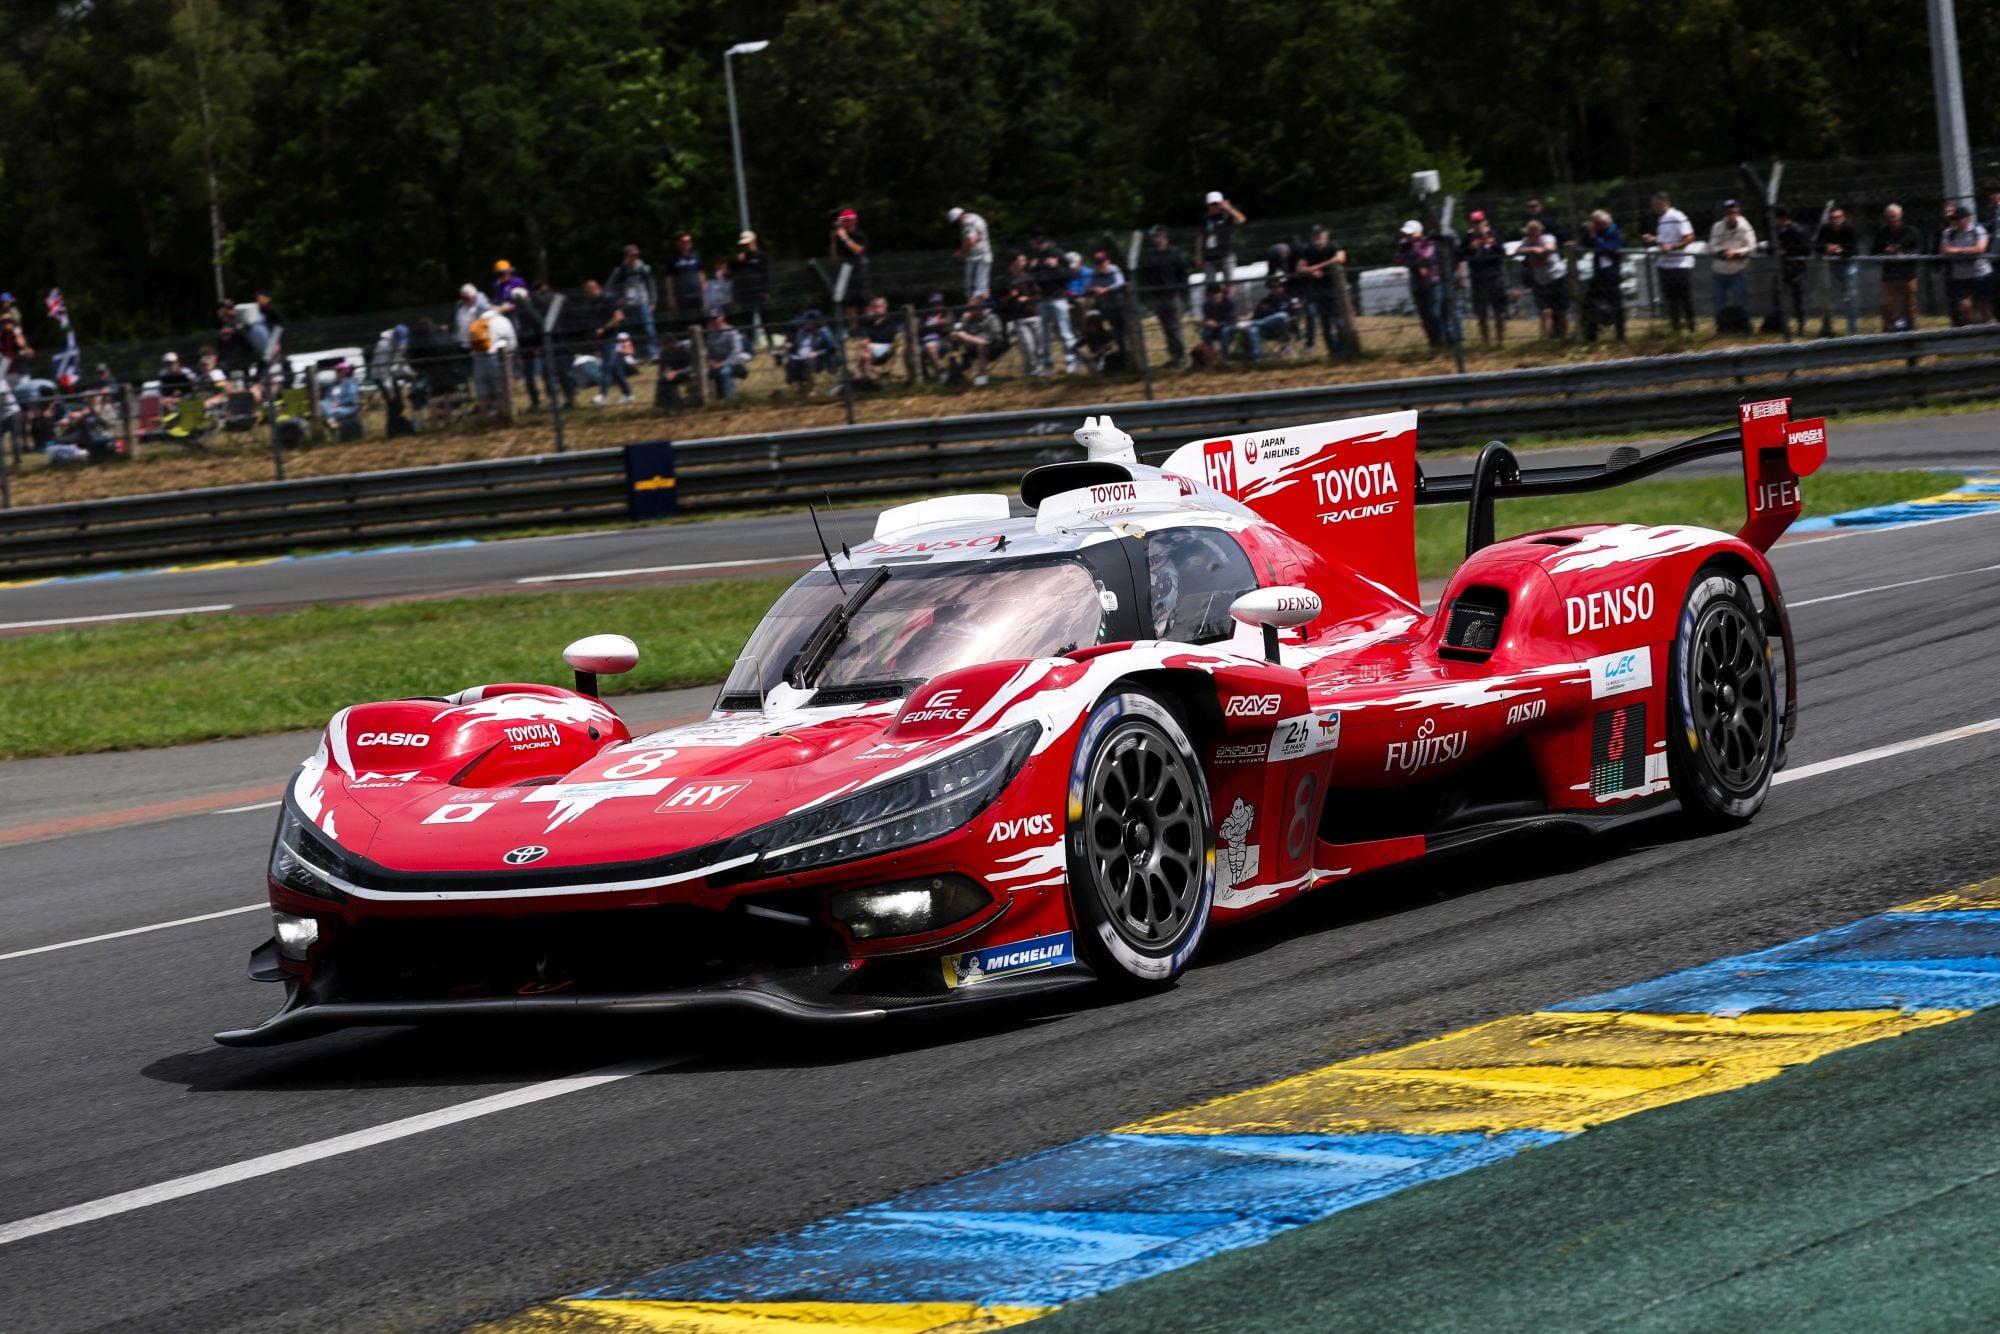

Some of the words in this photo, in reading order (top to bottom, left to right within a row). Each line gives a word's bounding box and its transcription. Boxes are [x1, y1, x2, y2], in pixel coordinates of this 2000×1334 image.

[1260, 436, 1286, 448] JAPAN
[1263, 447, 1300, 460] AIRLINES
[1205, 450, 1233, 493] HY
[1312, 461, 1399, 505] TOYOTA
[1090, 484, 1137, 504] TOYOTA
[1754, 481, 1794, 511] JFE
[1316, 501, 1399, 524] RACING
[854, 534, 1003, 554] DENSO
[1276, 596, 1320, 611] DENSO
[1565, 582, 1655, 635] DENSO
[1604, 655, 1636, 678] WEC
[901, 708, 971, 724] EDIFICE
[1225, 694, 1281, 717] RAYS
[1506, 699, 1547, 725] AISIN
[356, 732, 430, 747] CASIO
[504, 724, 550, 743] TOYOTA
[549, 723, 561, 746] 8
[510, 740, 552, 751] RACING
[602, 749, 679, 779] 8
[1384, 731, 1468, 775] FUJITSU
[665, 784, 743, 807] HY
[1287, 771, 1317, 860] 8
[986, 943, 1064, 971] MICHELIN
